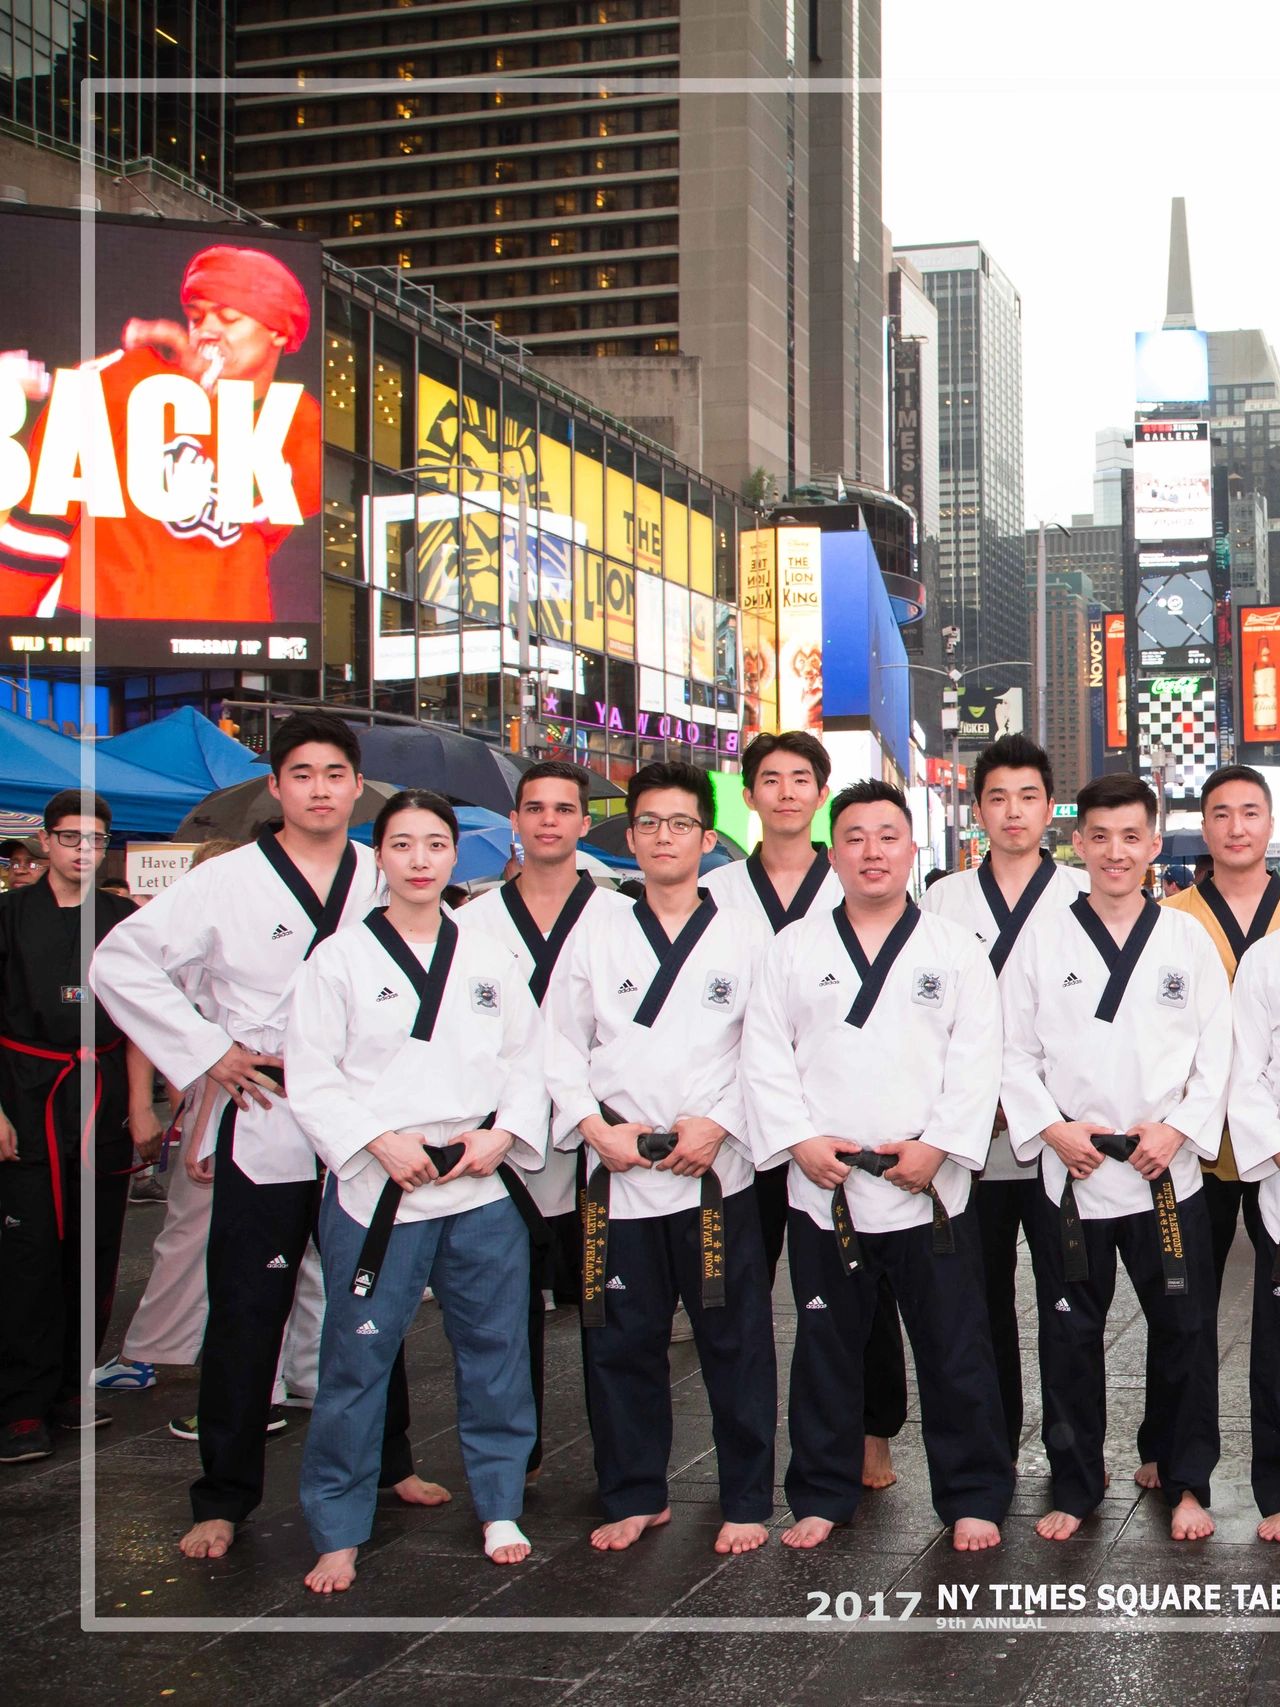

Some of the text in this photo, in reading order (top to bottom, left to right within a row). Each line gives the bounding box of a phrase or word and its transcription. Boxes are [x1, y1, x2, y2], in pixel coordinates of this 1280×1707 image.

[897, 368, 917, 472] TIMES
[1144, 431, 1199, 442] GALLERY
[623, 510, 661, 556] THE
[788, 557, 809, 567] THE
[784, 569, 814, 586] LION
[782, 588, 818, 608] KING
[11, 635, 45, 652] WILD
[65, 636, 92, 653] OUT
[170, 638, 237, 655] THURSDAY
[141, 856, 176, 869] Have
[137, 875, 159, 888] Let
[1162, 1182, 1184, 1259] UNITED TAEKWONDO
